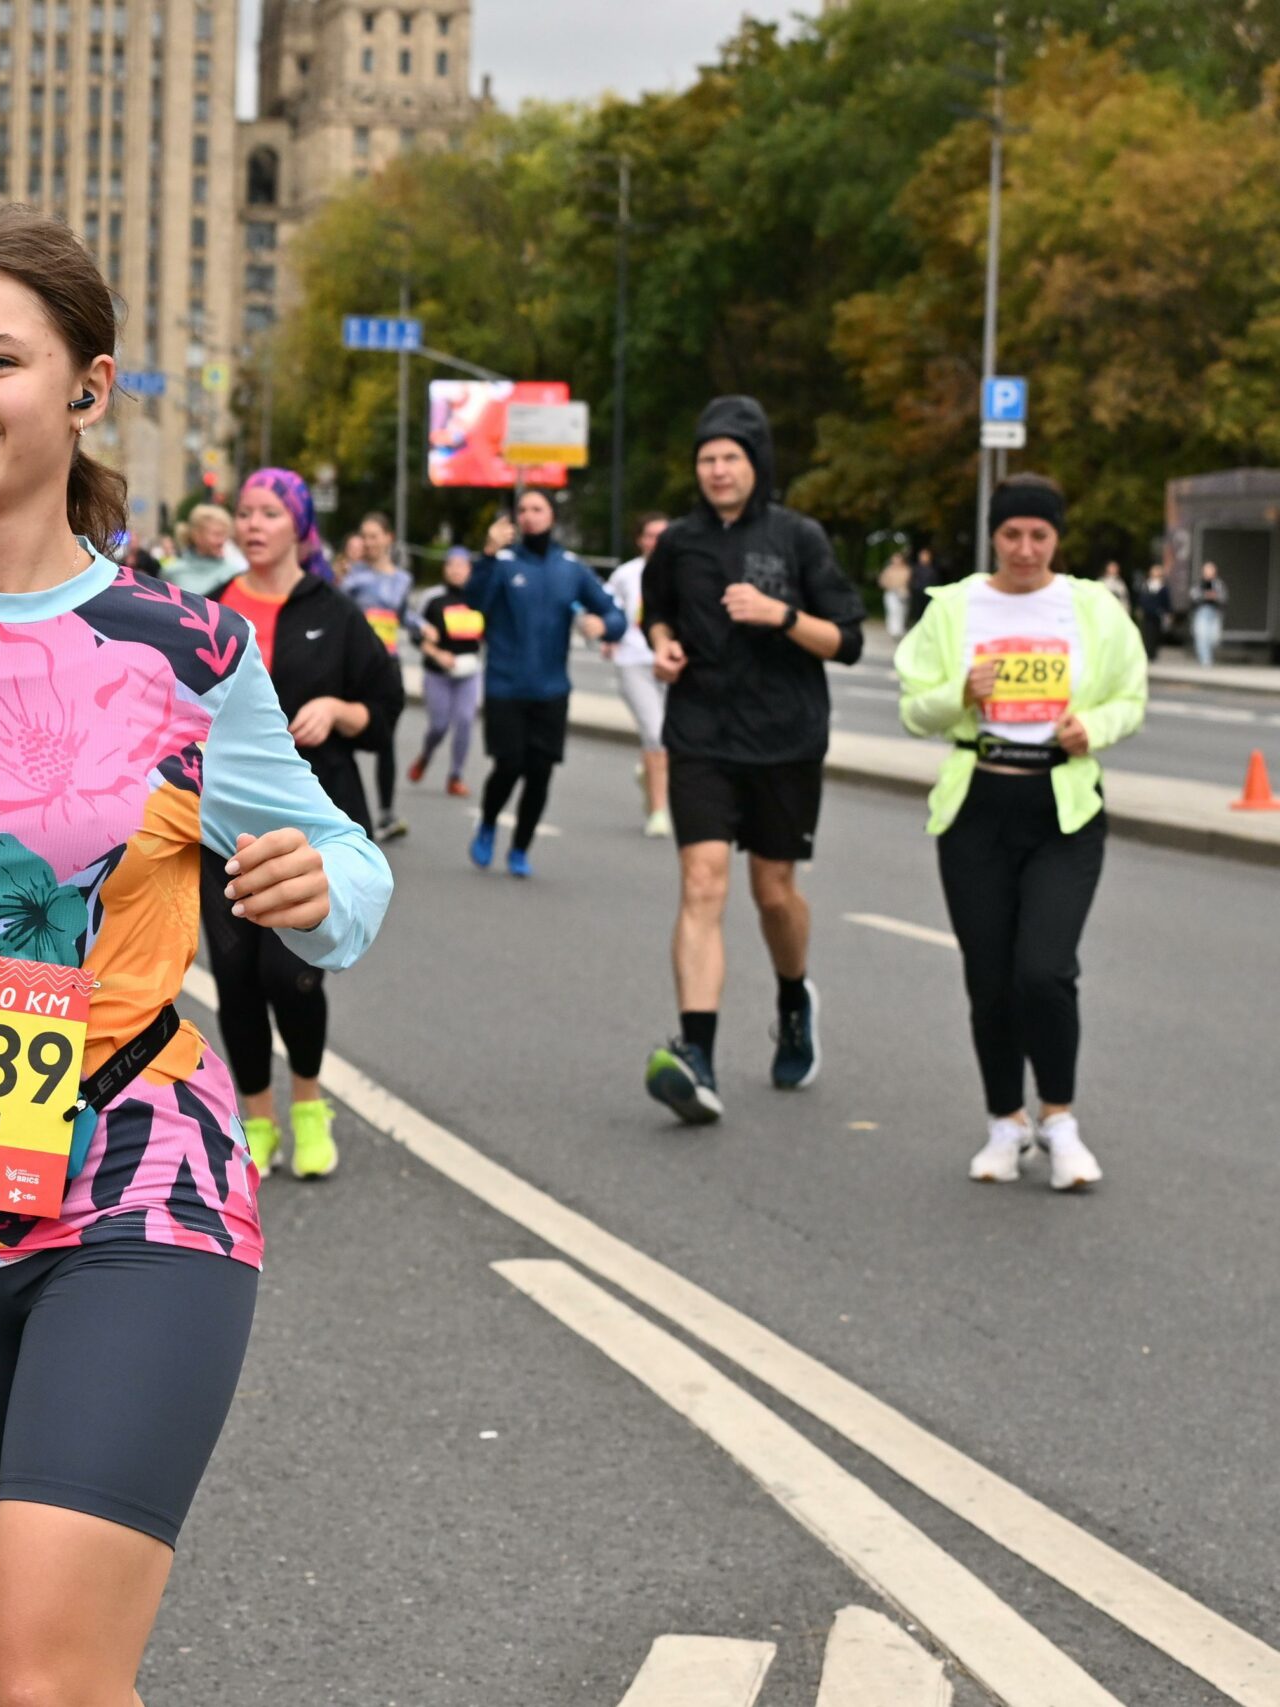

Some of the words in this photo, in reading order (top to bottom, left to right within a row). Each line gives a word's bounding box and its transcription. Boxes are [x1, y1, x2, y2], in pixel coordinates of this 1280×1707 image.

[993, 381, 1018, 418] P
[992, 659, 1066, 683] 4289
[16, 1175, 40, 1185] BRICS
